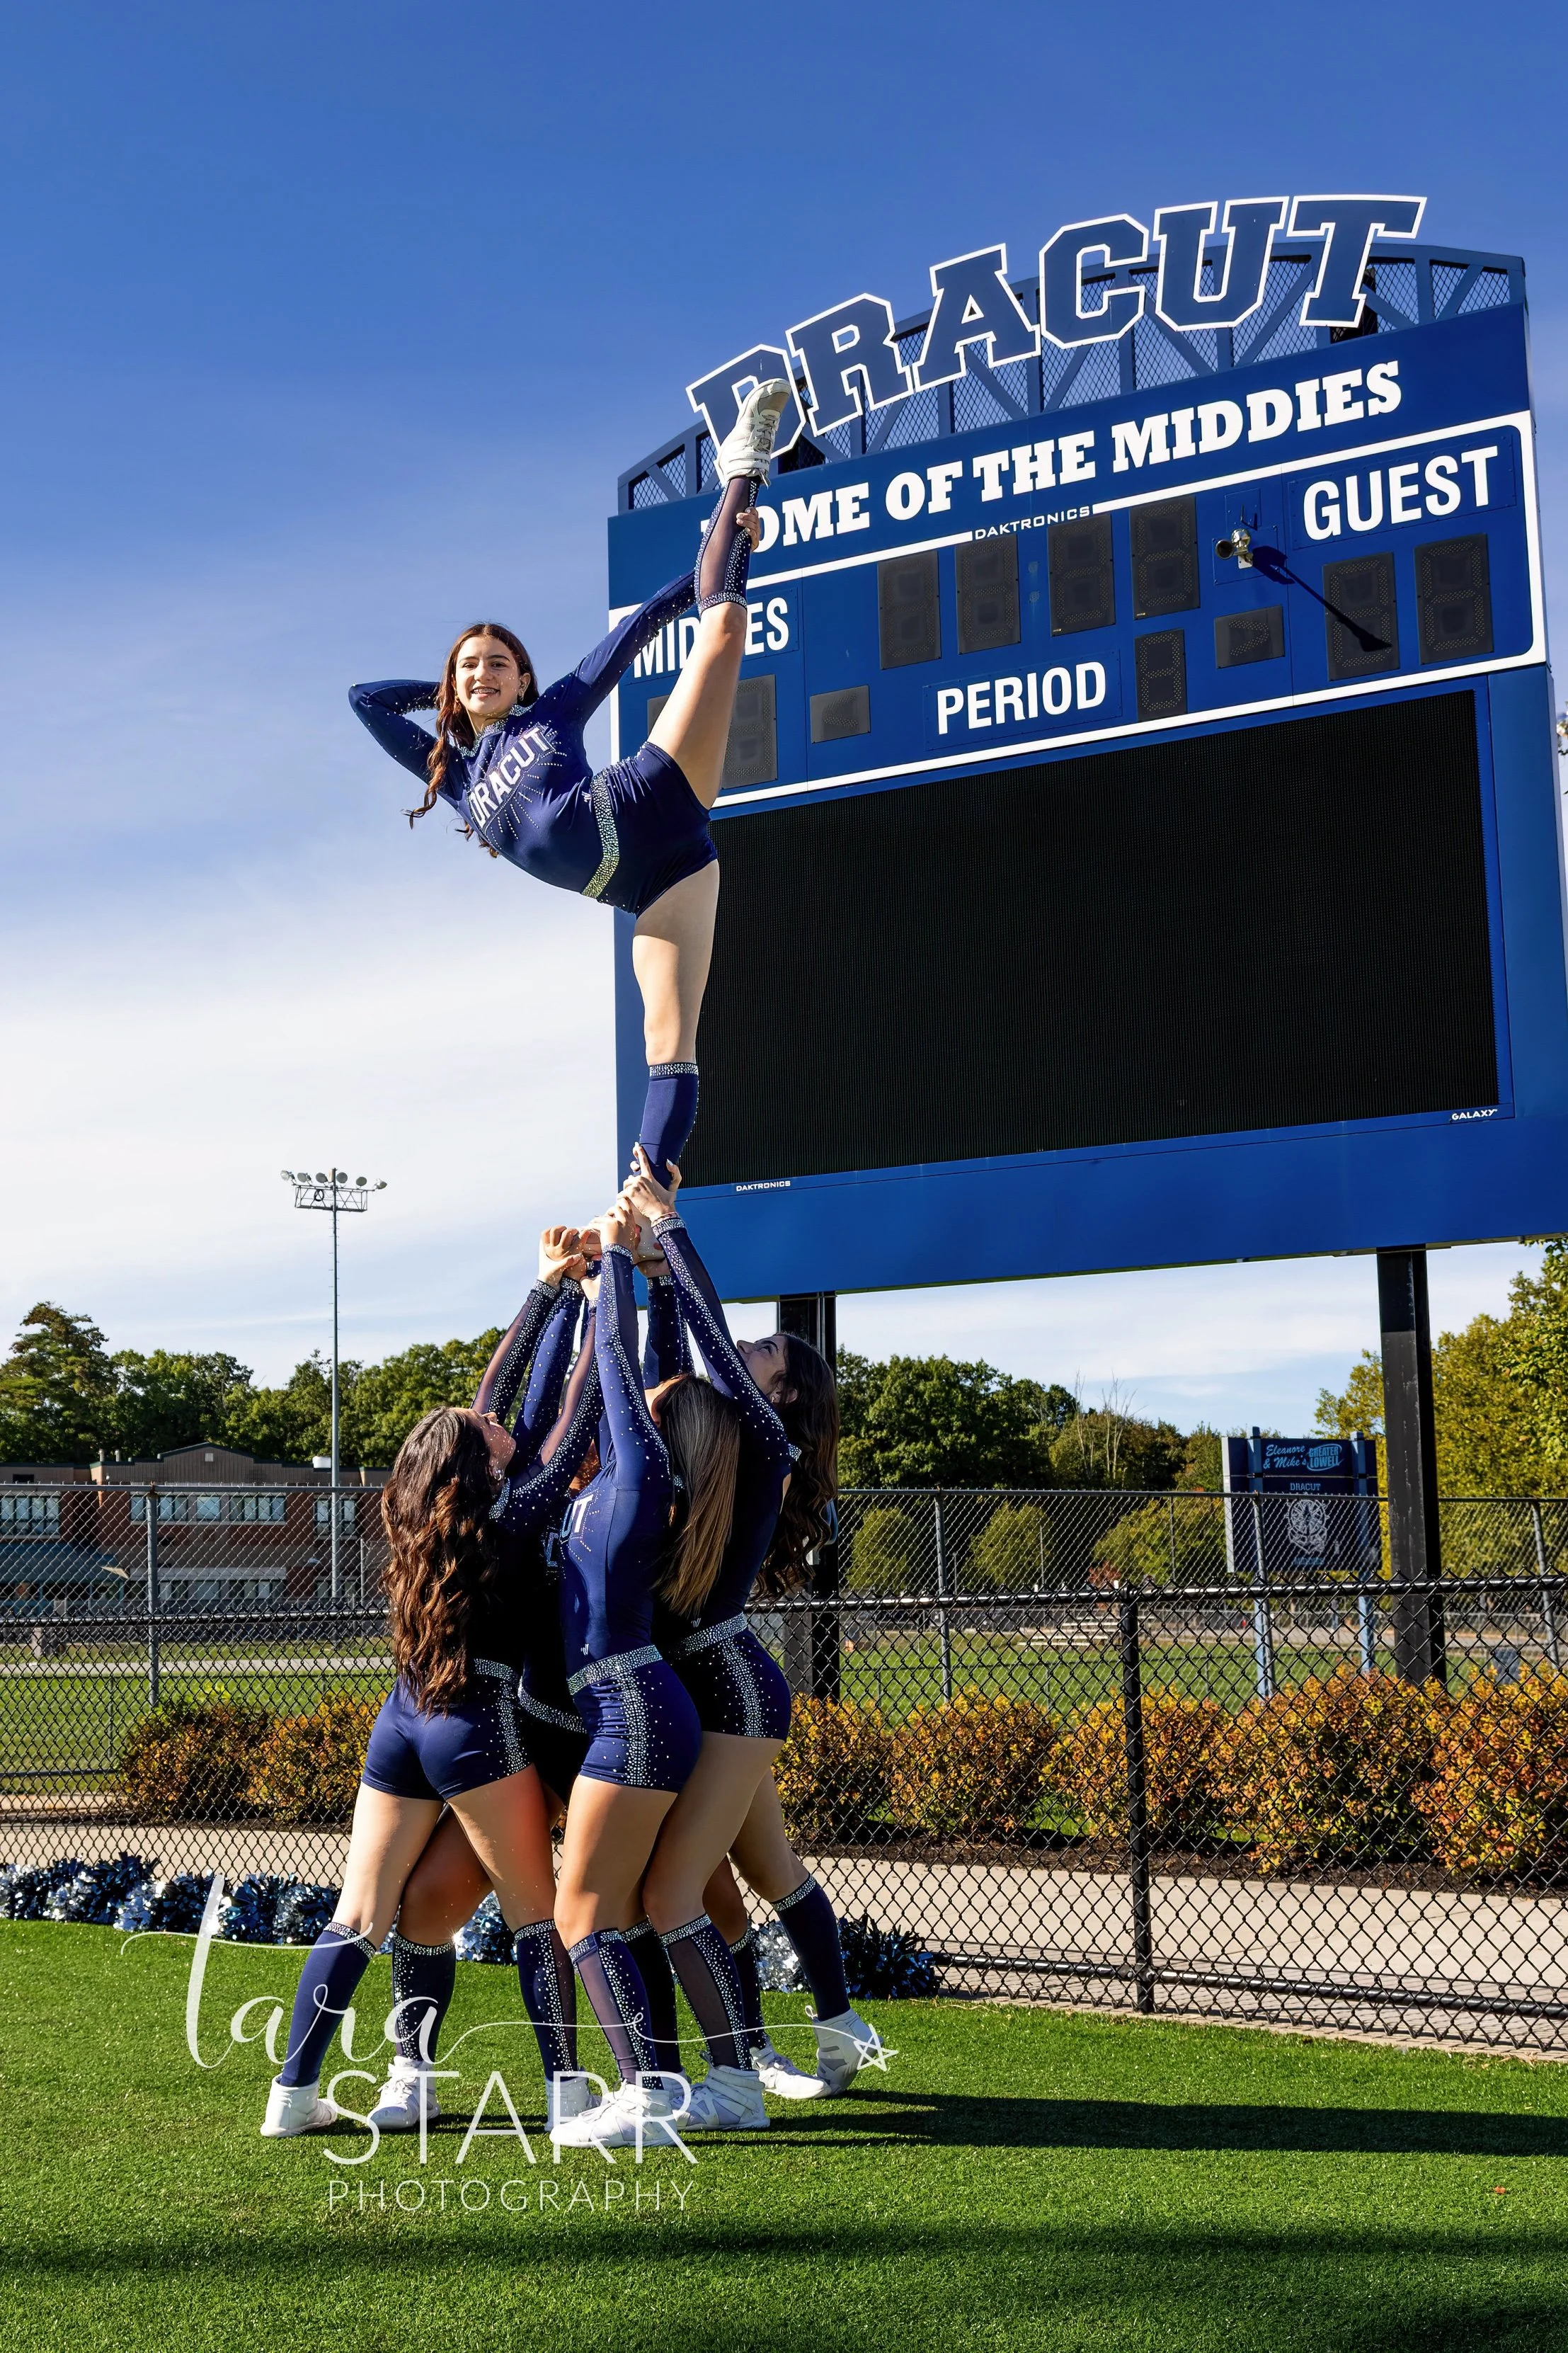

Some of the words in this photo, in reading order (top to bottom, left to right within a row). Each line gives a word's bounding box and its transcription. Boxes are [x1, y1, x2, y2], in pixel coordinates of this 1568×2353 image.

[686, 195, 1427, 491] DRACUT
[700, 483, 870, 553] OME
[886, 460, 963, 520] OF
[973, 430, 1096, 502] THE
[1111, 360, 1402, 473] MIDDIES
[1303, 445, 1498, 540] GUEST
[975, 506, 1090, 541] DAKTRONICS
[634, 597, 789, 678] MIDES
[937, 661, 1106, 735] PERIOD
[467, 727, 551, 830] DRACUT
[1451, 1109, 1497, 1120] GALAXY
[736, 1180, 791, 1192] DAKTRONICS
[1263, 1458, 1271, 1469] &
[1274, 1454, 1307, 1468] Mike's
[1266, 1445, 1306, 1457] Eleanore
[1308, 1446, 1339, 1457] GREATER
[1310, 1455, 1340, 1468] LOWELL
[1290, 1482, 1321, 1491] DRACUT
